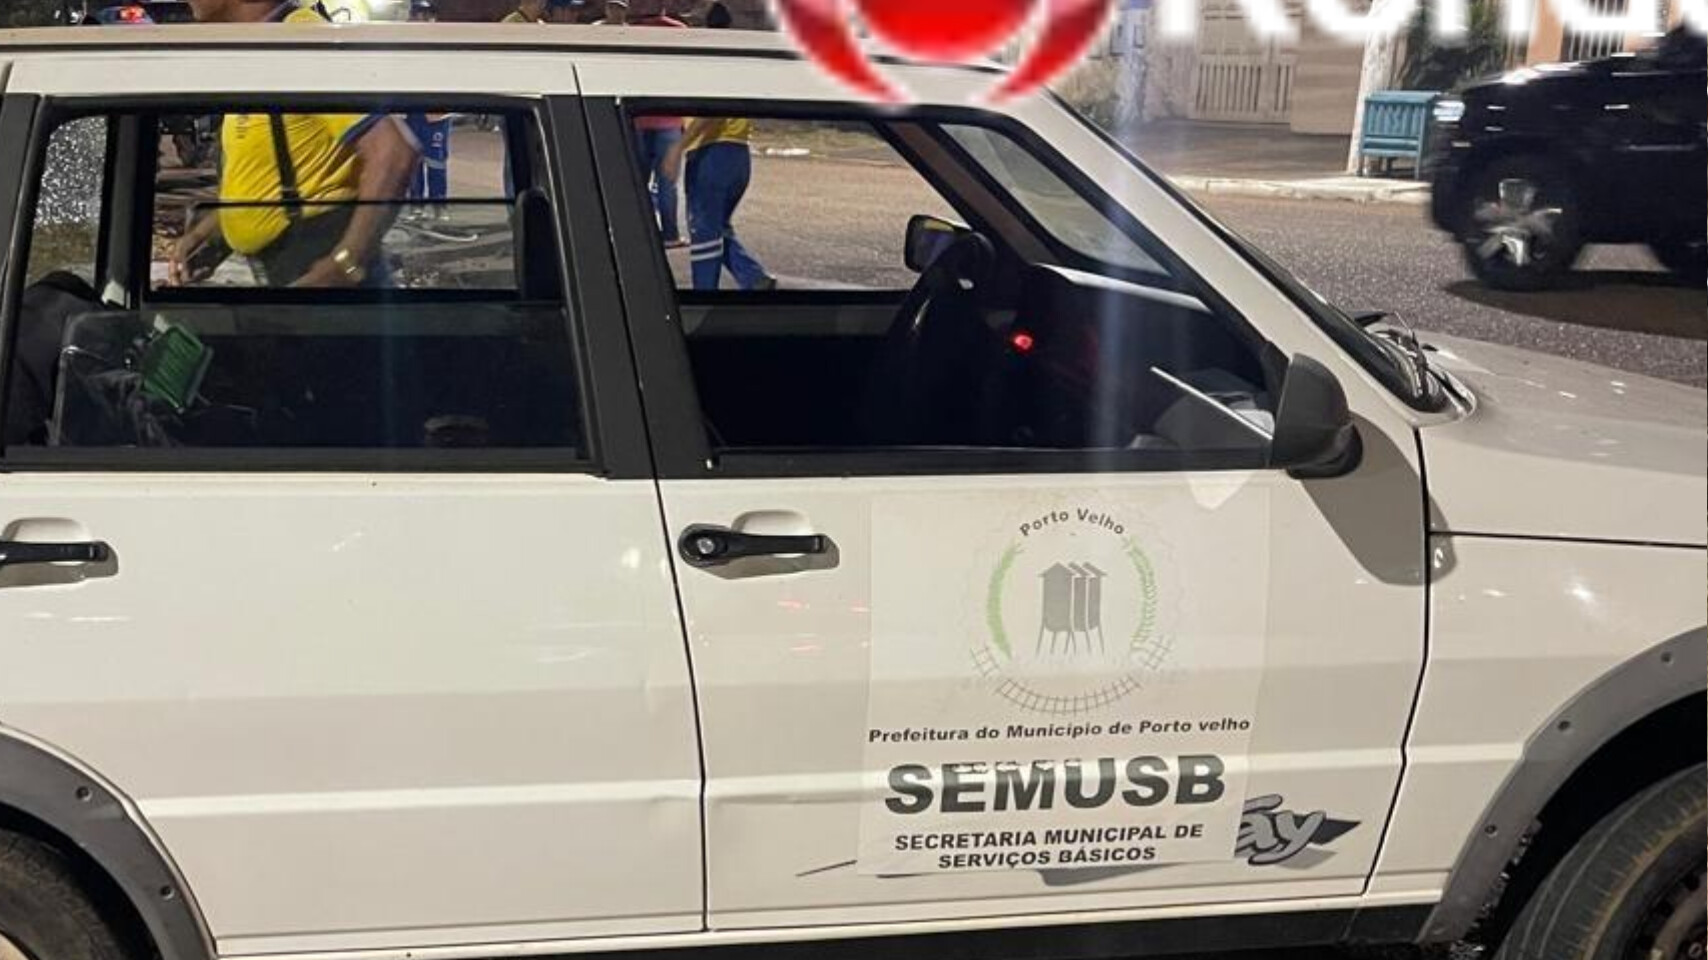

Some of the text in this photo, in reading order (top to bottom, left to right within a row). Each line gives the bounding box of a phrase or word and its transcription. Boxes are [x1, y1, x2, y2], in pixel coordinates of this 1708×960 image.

[1020, 508, 1125, 536] Porto Velho
[869, 727, 969, 743] Prefeitura
[975, 726, 1000, 739] do
[1108, 721, 1133, 735] de
[1139, 719, 1193, 734] Porto
[1199, 717, 1250, 732] velho
[884, 753, 1226, 815] SEMUSB
[895, 823, 1204, 851] SECRETARIA MUNICIPAL DE
[938, 845, 1156, 870] SERVIÇOS BÁSICOS
